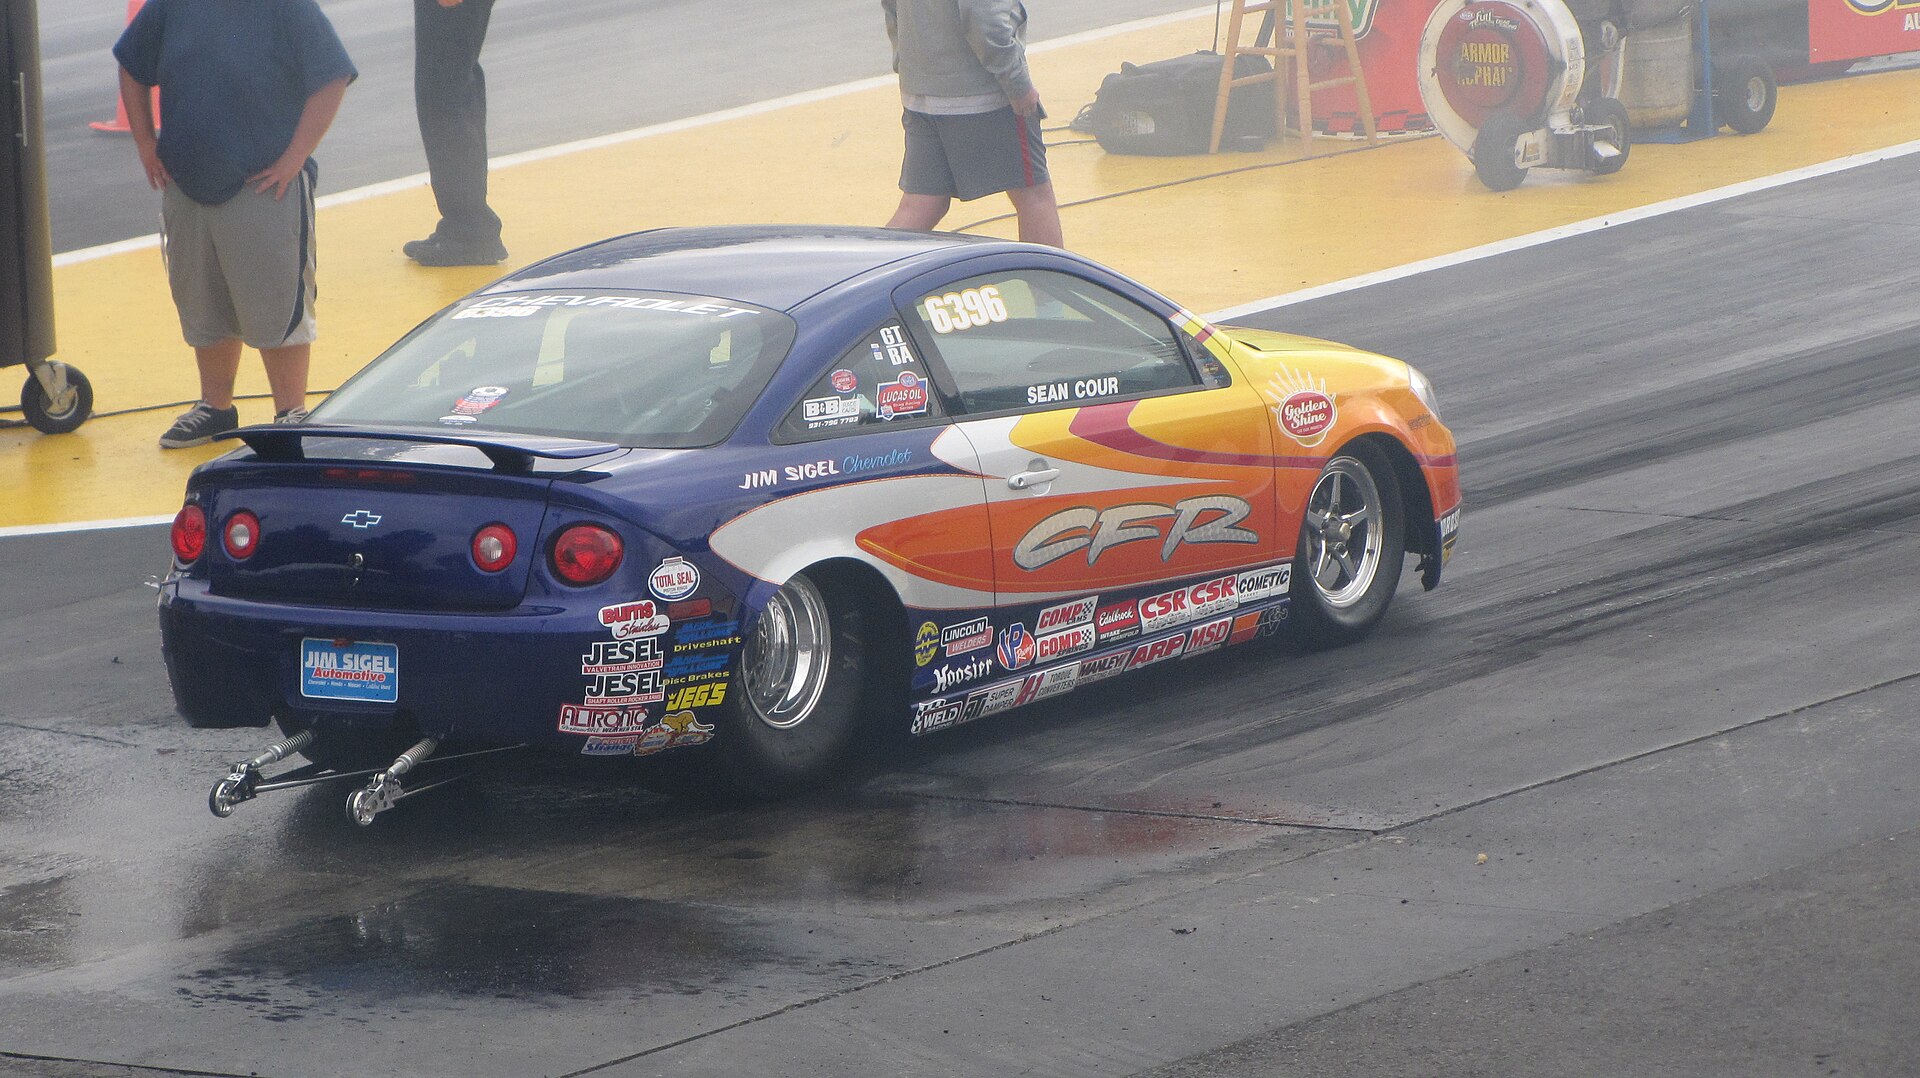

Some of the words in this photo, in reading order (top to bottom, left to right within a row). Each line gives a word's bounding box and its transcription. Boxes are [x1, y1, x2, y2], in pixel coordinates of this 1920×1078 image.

[1461, 42, 1509, 64] ARMOR
[467, 295, 761, 318] CHEVROLET
[923, 284, 1008, 334] 6396
[879, 325, 903, 345] GT
[887, 345, 915, 366] BA
[881, 389, 908, 404] LUCAS
[909, 388, 922, 400] OIL
[1027, 382, 1069, 404] SEAN
[1074, 376, 1119, 399] COUR
[805, 399, 839, 417] B&B
[1284, 400, 1328, 421] Golden
[1291, 412, 1327, 429] Shine
[738, 469, 778, 489] JIM
[784, 460, 840, 481] SIGEL
[842, 448, 912, 474] Chevrolet
[1013, 493, 1260, 572] CFR
[654, 573, 676, 588] TOTAL
[677, 571, 694, 585] SEAL
[1190, 576, 1236, 605] CSR
[1239, 570, 1290, 594] COMETIC
[1141, 589, 1187, 619] CSR
[1039, 603, 1084, 629] COMP
[1099, 605, 1134, 627] Edelbrock
[945, 621, 985, 642] LINCOLN
[1187, 620, 1229, 651] MSD
[583, 638, 661, 666] JESEL
[673, 636, 742, 653] Driveshaft
[952, 635, 987, 652] WELDERS
[998, 622, 1025, 671] VP
[1039, 630, 1082, 658] COMP
[1130, 635, 1185, 667] ARP
[305, 651, 338, 669] JIM
[342, 653, 395, 674] SIGEL
[586, 664, 626, 673] VALVETRAIN
[626, 661, 660, 671] INNOVATION
[312, 667, 386, 682] Automotive
[586, 671, 662, 697] JESEL
[662, 677, 686, 686] Disc
[687, 671, 730, 682] Brakes
[930, 655, 993, 694] Hoosier
[989, 687, 1015, 702] SUPER
[923, 706, 959, 729] WELD
